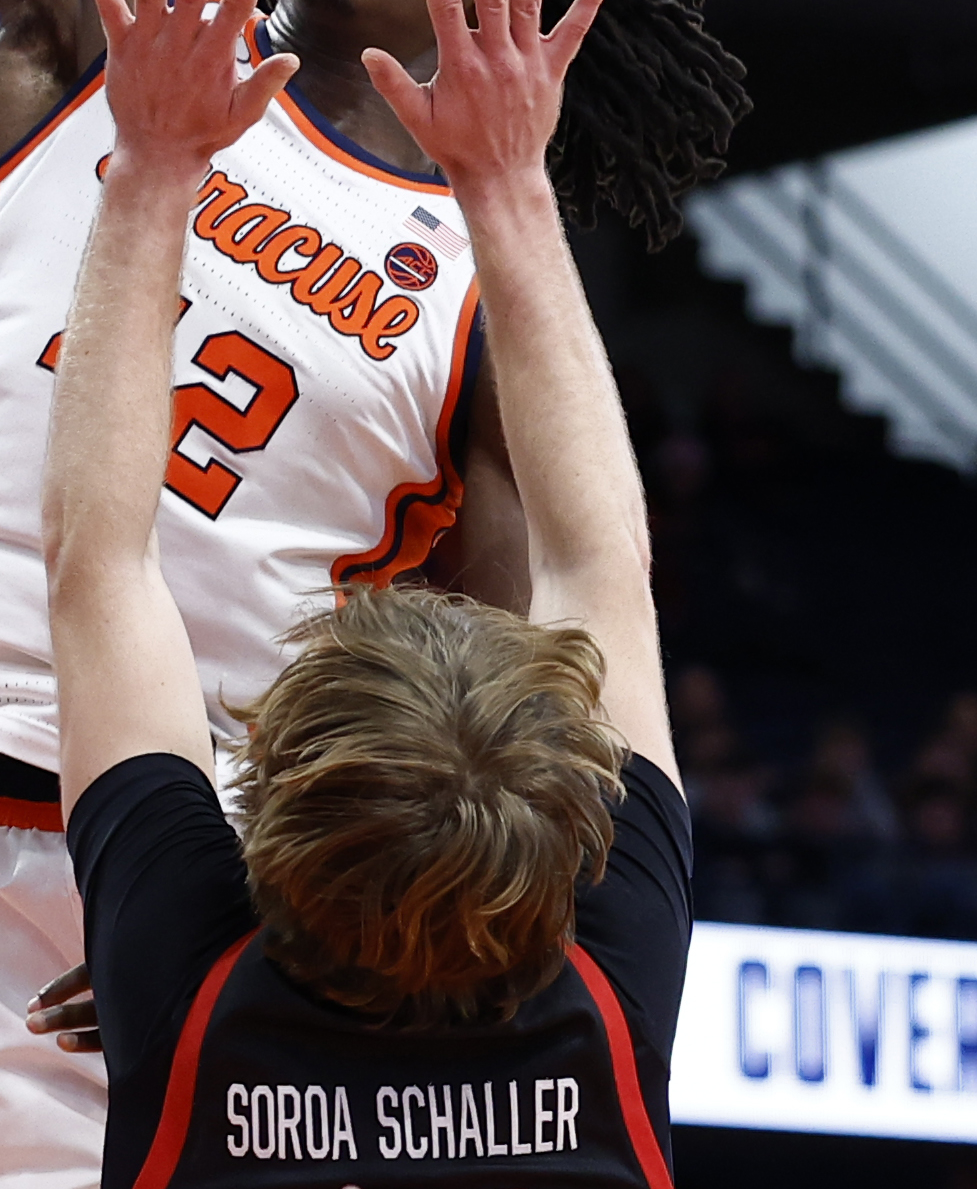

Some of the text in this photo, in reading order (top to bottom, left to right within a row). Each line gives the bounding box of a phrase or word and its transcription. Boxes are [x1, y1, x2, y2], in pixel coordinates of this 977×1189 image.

[96, 150, 420, 361] racuse
[227, 1076, 579, 1161] SOROA SCHALLER
